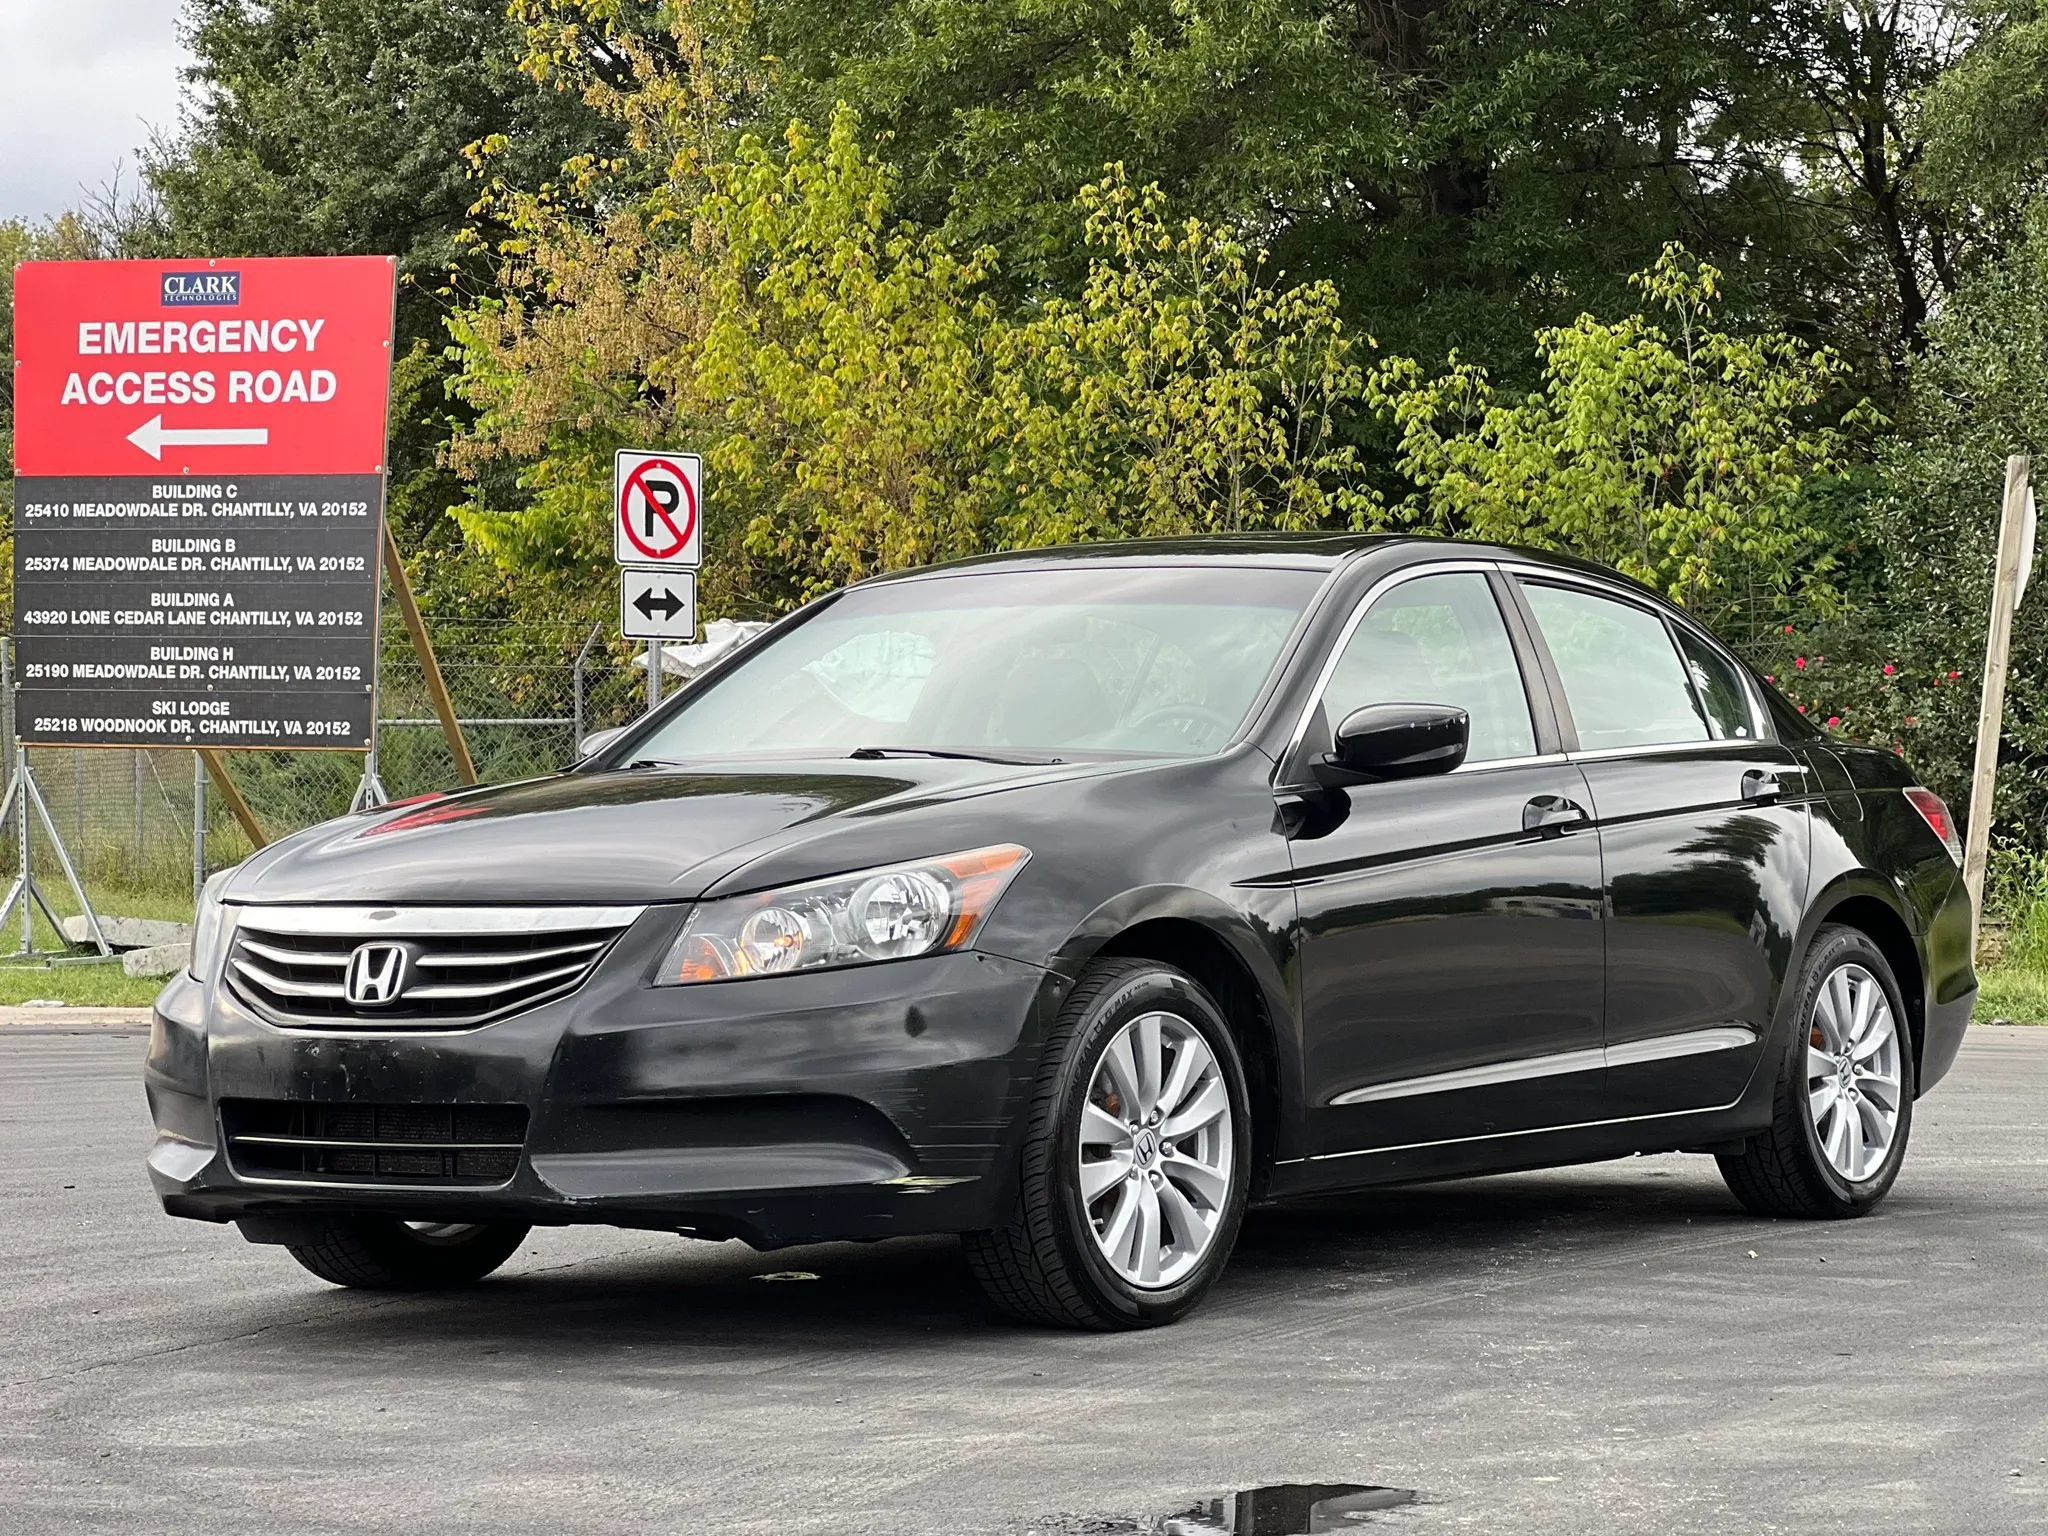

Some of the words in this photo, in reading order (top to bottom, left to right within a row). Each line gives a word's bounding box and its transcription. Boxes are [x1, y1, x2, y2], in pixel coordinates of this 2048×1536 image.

[164, 275, 237, 294] CLARK
[164, 294, 238, 302] TECHNOLOGIES
[80, 320, 324, 354] EMERGENCY
[62, 371, 215, 404] ACCESS
[229, 370, 336, 402] ROAD
[152, 485, 223, 498] BUILDING
[225, 484, 238, 498] C
[24, 504, 70, 517] 25410
[72, 503, 179, 517] MEADOWDALE
[181, 503, 208, 516] DR.
[211, 502, 295, 519] CHANTILLY,
[298, 502, 318, 516] VA
[321, 502, 368, 516] 20152
[151, 539, 222, 552] BUILDING
[225, 539, 236, 552] B
[24, 558, 70, 570] 25374
[72, 557, 178, 571] MEADOWDALE
[181, 557, 207, 570] DR.
[210, 557, 293, 573] CHANTILLY,
[296, 557, 317, 570] VA
[319, 557, 365, 570] 20152
[150, 593, 220, 606] BUILDING
[222, 593, 235, 606] A
[23, 611, 68, 624] 43920
[71, 611, 111, 624] LONE
[113, 611, 165, 624] CEDAR
[167, 611, 207, 624] LANE
[209, 611, 292, 627] CHANTILLY,
[294, 611, 315, 625] VA
[317, 612, 363, 625] 20152
[150, 647, 219, 660] BUILDING
[222, 647, 234, 660] H
[25, 664, 69, 677] 25190
[72, 664, 176, 678] MEADOWDALE
[179, 665, 205, 678] DR.
[208, 665, 290, 682] CHANTILLY,
[293, 666, 313, 679] VA
[315, 666, 361, 680] 20152
[151, 701, 177, 714] SKI
[180, 701, 230, 715] LODGE
[34, 718, 78, 731] 25218
[80, 719, 168, 732] WOODNOOK
[170, 720, 196, 733] DR.
[199, 720, 280, 737] CHANTILLY,
[283, 721, 303, 734] VA
[305, 721, 351, 735] 20152
